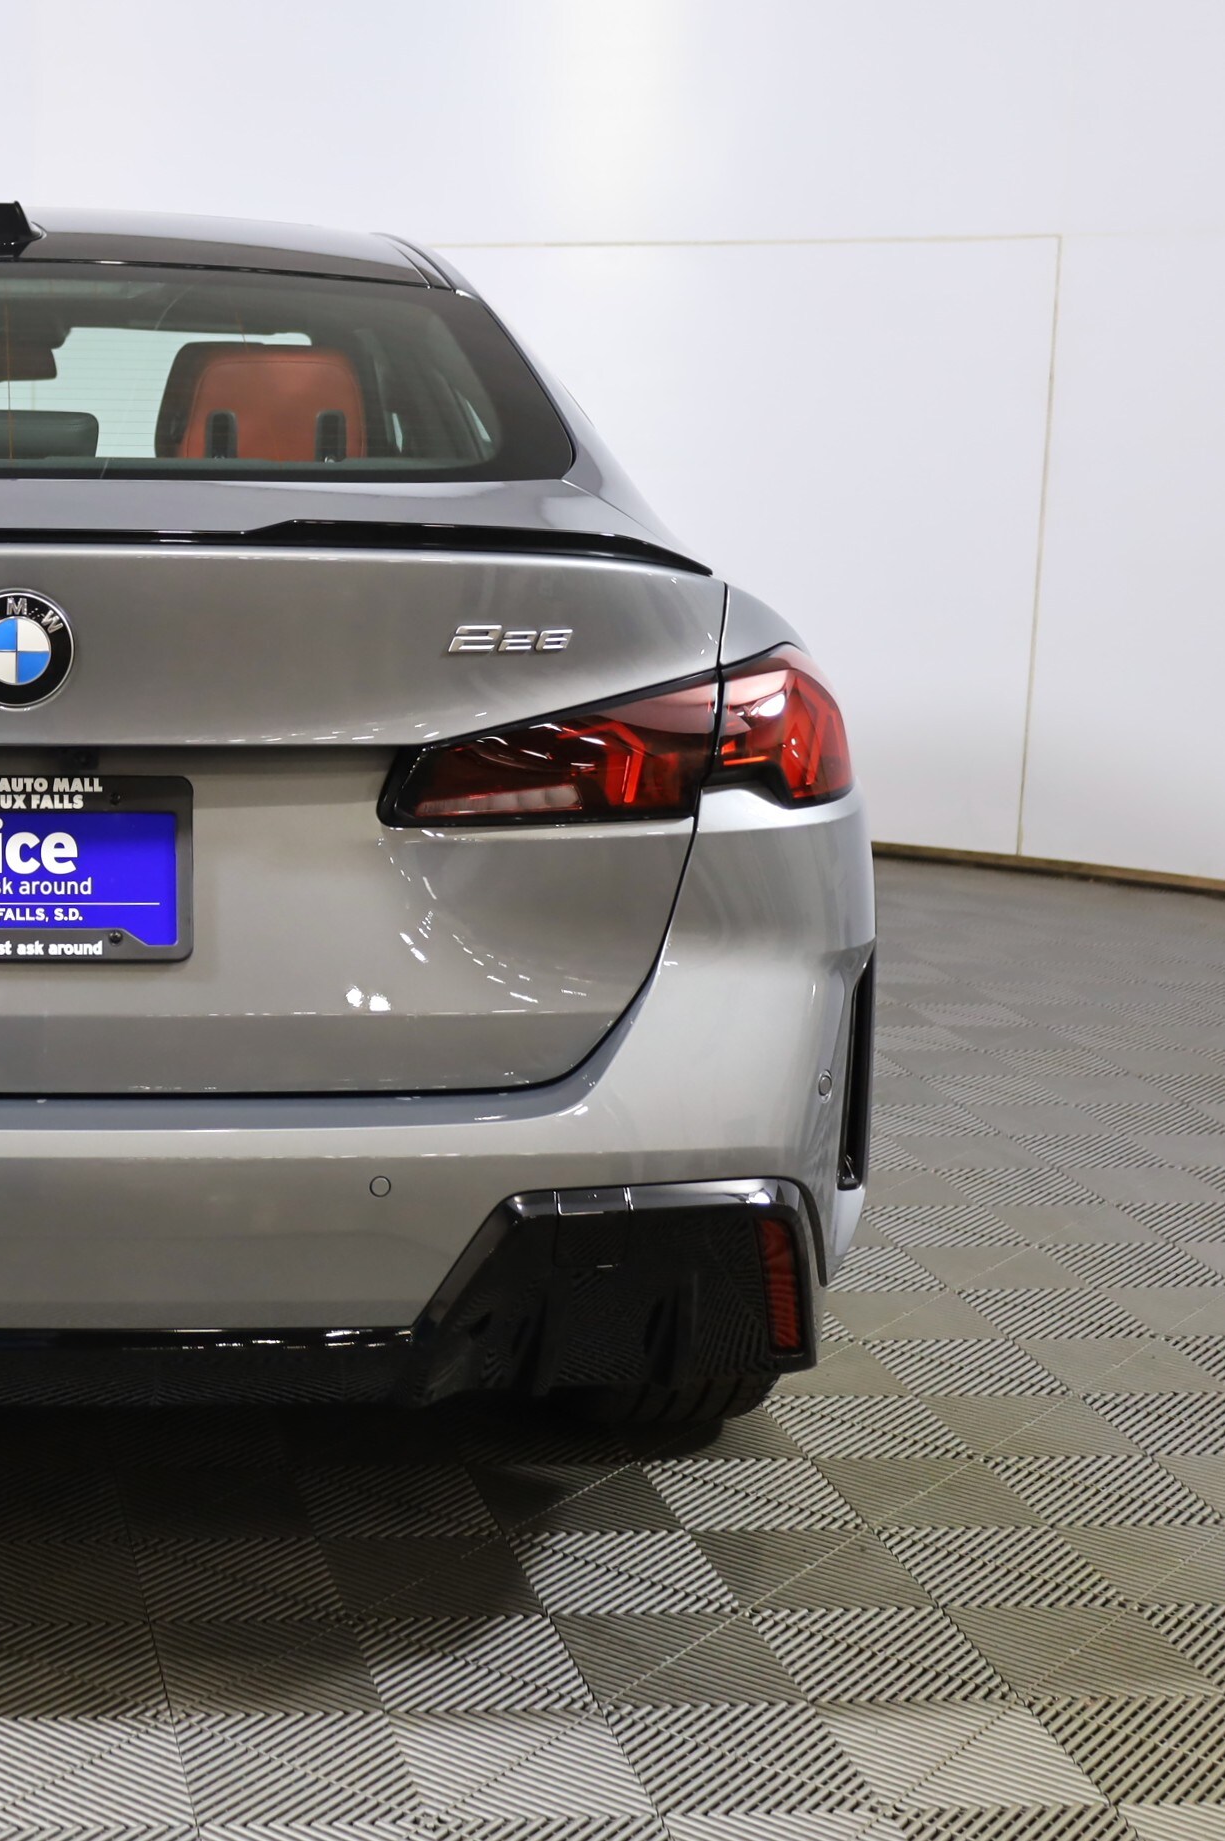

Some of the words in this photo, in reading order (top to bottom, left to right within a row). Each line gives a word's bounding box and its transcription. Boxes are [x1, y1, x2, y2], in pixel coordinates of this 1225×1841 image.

[448, 624, 573, 652] 228
[53, 777, 103, 793] MALL
[31, 794, 84, 810] FALLS
[18, 876, 93, 896] around
[53, 908, 83, 922] S.D.
[16, 940, 45, 956] ask
[48, 940, 103, 956] around
